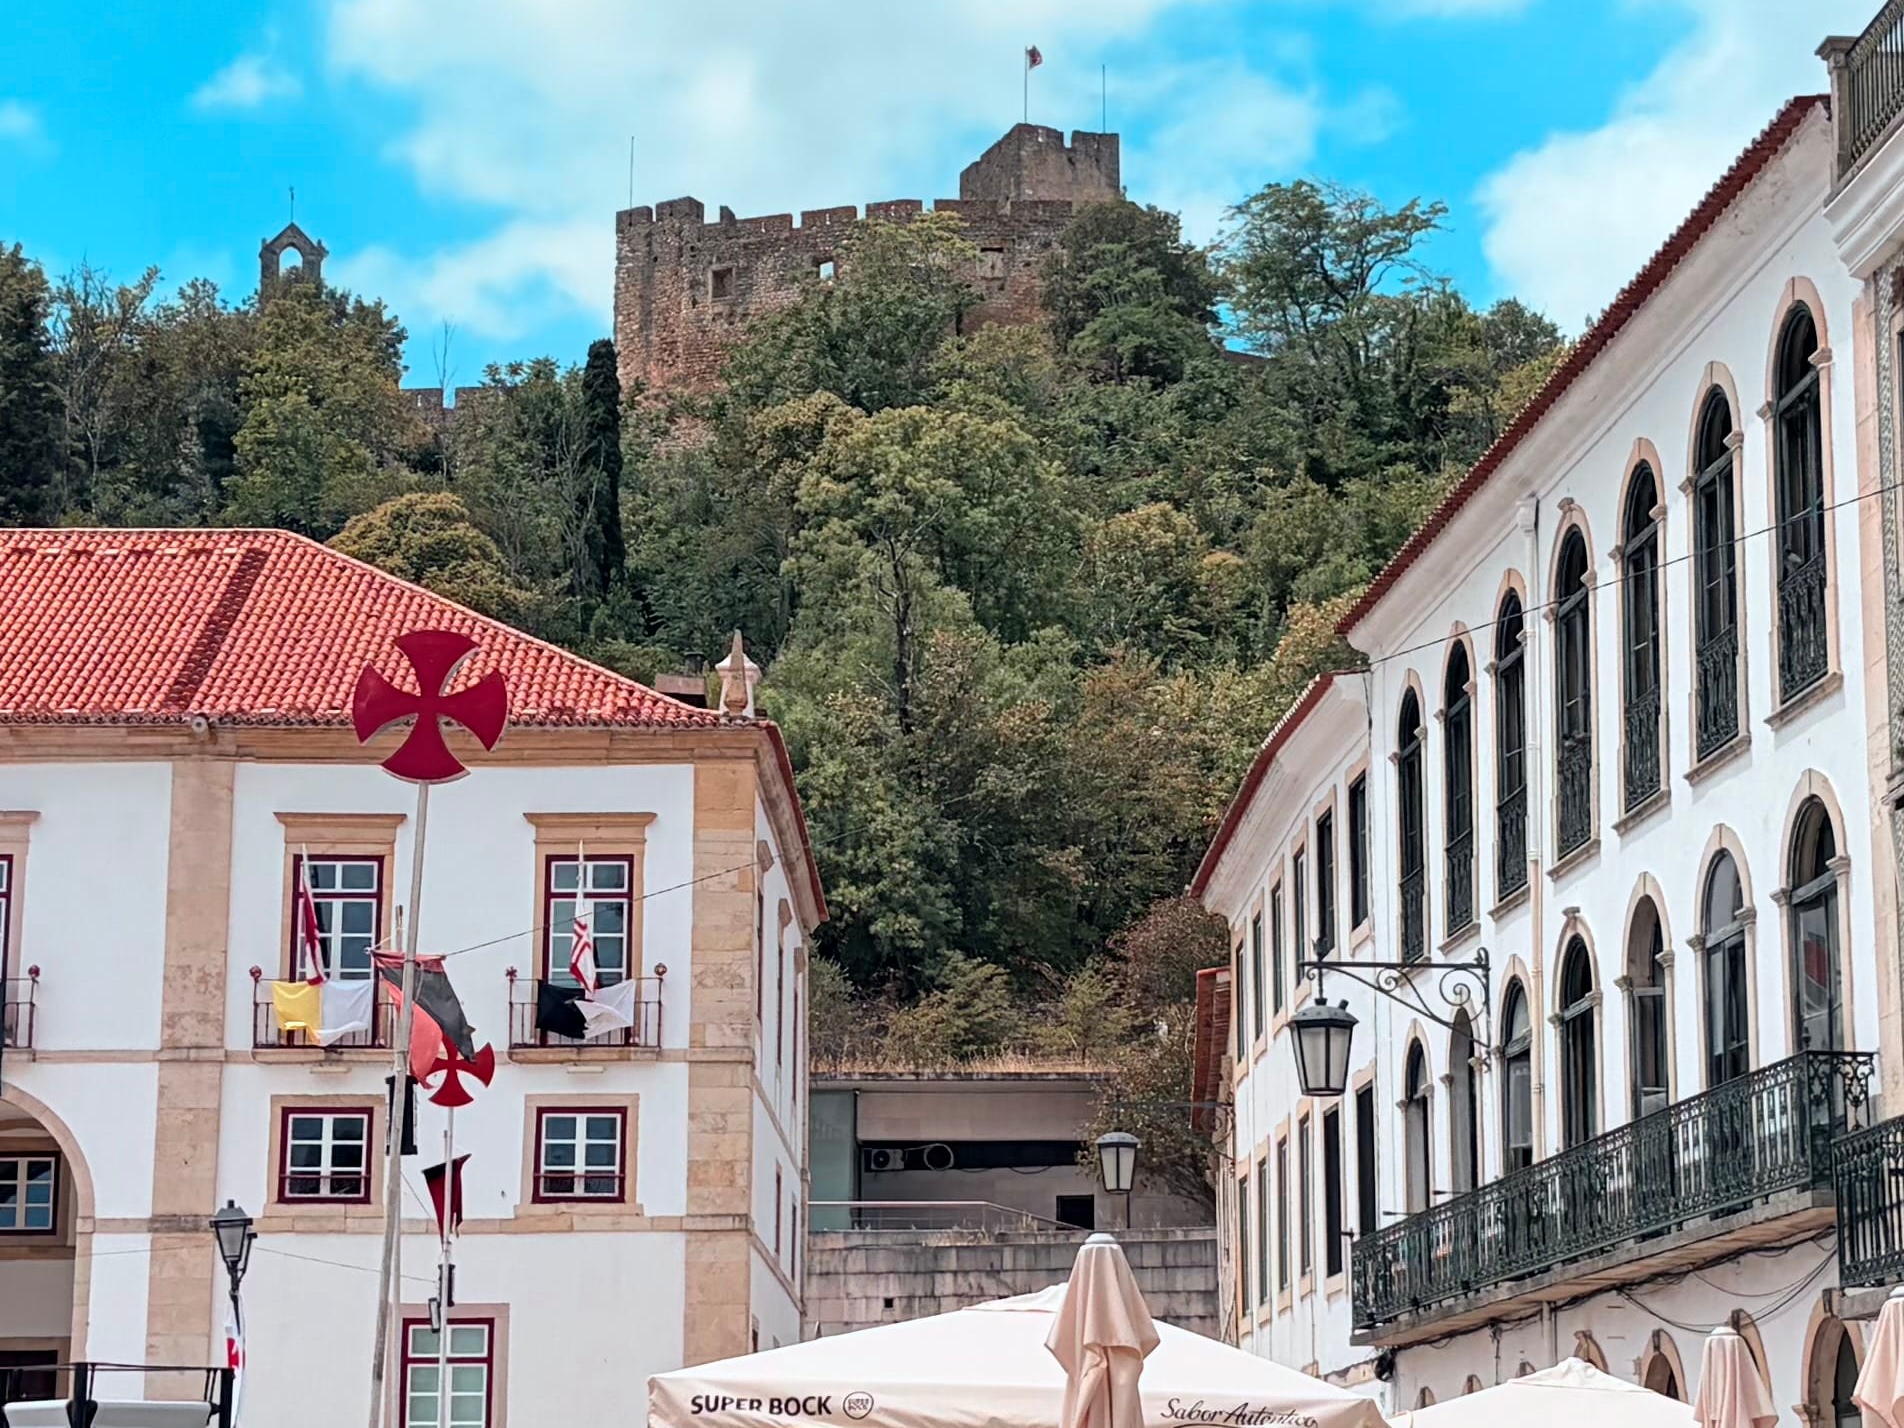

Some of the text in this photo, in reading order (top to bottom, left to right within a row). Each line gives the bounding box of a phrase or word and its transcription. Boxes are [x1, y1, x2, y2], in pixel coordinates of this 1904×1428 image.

[691, 1394, 833, 1416] SUPER BOCK
[1160, 1397, 1224, 1422] Sabor
